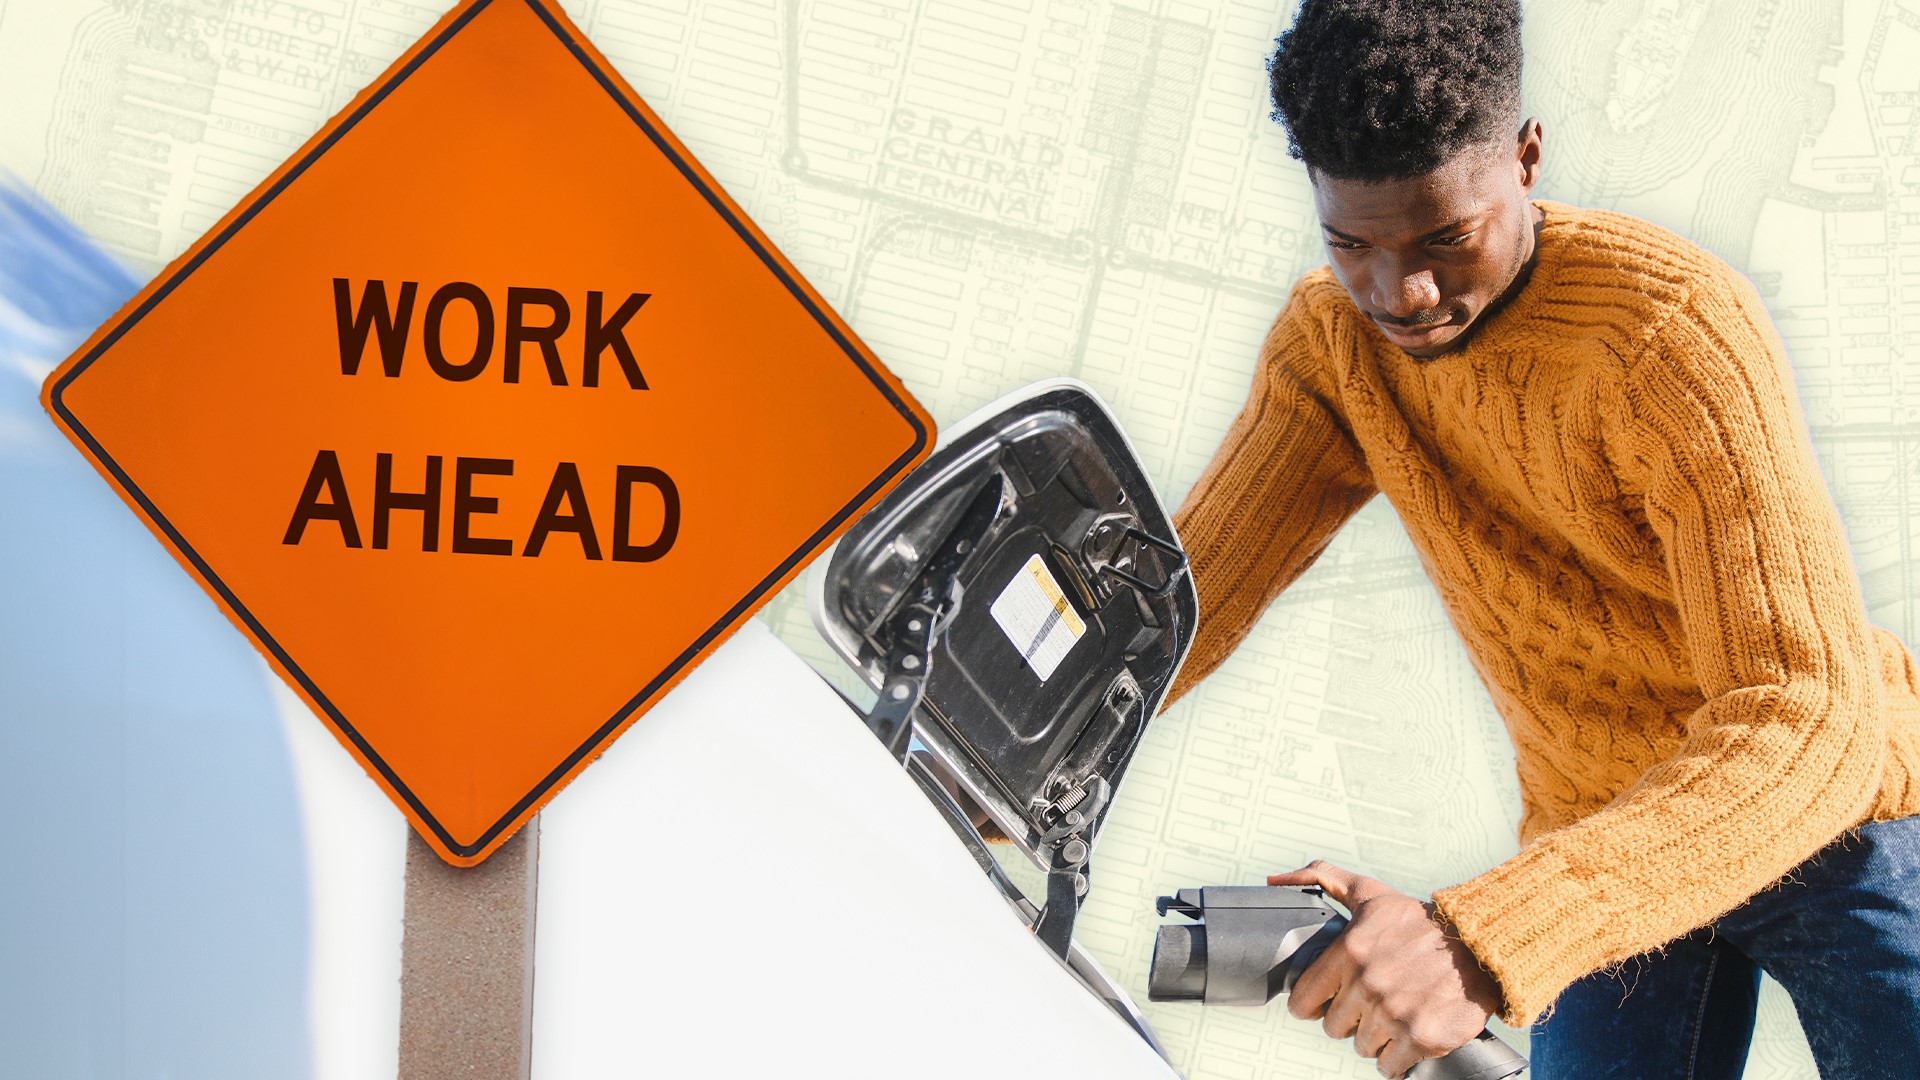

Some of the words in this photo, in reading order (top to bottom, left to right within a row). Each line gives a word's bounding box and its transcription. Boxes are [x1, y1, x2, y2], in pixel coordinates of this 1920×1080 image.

[202, 14, 302, 59] SHORE
[883, 136, 1055, 197] CENTRAL
[891, 106, 1065, 167] GRAND
[879, 162, 1055, 226] TERMINAL
[332, 278, 652, 391] WORK
[282, 449, 681, 564] AHEAD
